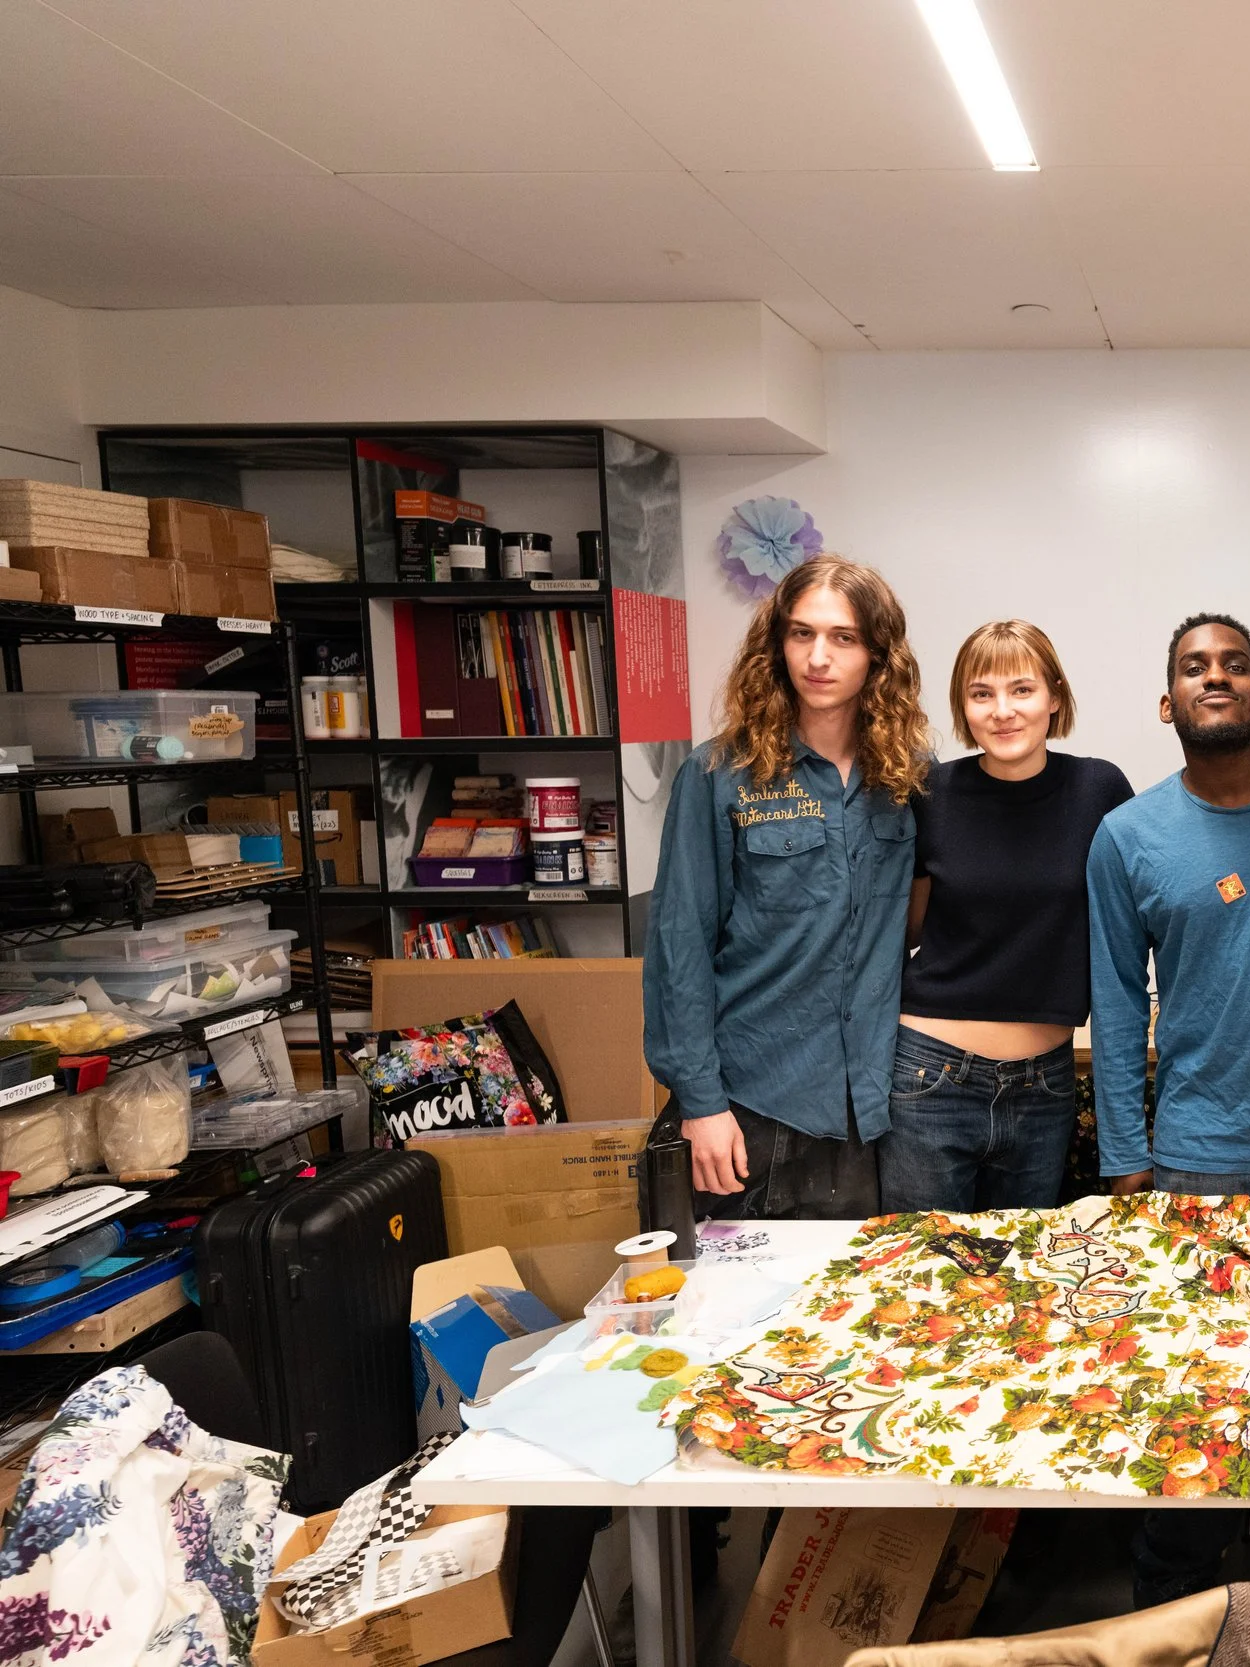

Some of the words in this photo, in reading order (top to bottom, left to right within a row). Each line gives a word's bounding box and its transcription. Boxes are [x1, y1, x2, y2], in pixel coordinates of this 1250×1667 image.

[78, 609, 98, 618] WOOD
[100, 610, 120, 619] TYPE
[126, 612, 154, 622] SPACING
[330, 652, 358, 672] Scott
[732, 806, 800, 827] Motorcars
[4, 1080, 48, 1100] TOTS/KIDS
[562, 1157, 588, 1165] TRUCK
[590, 1154, 612, 1163] HAND
[769, 1536, 822, 1630] TRADER
